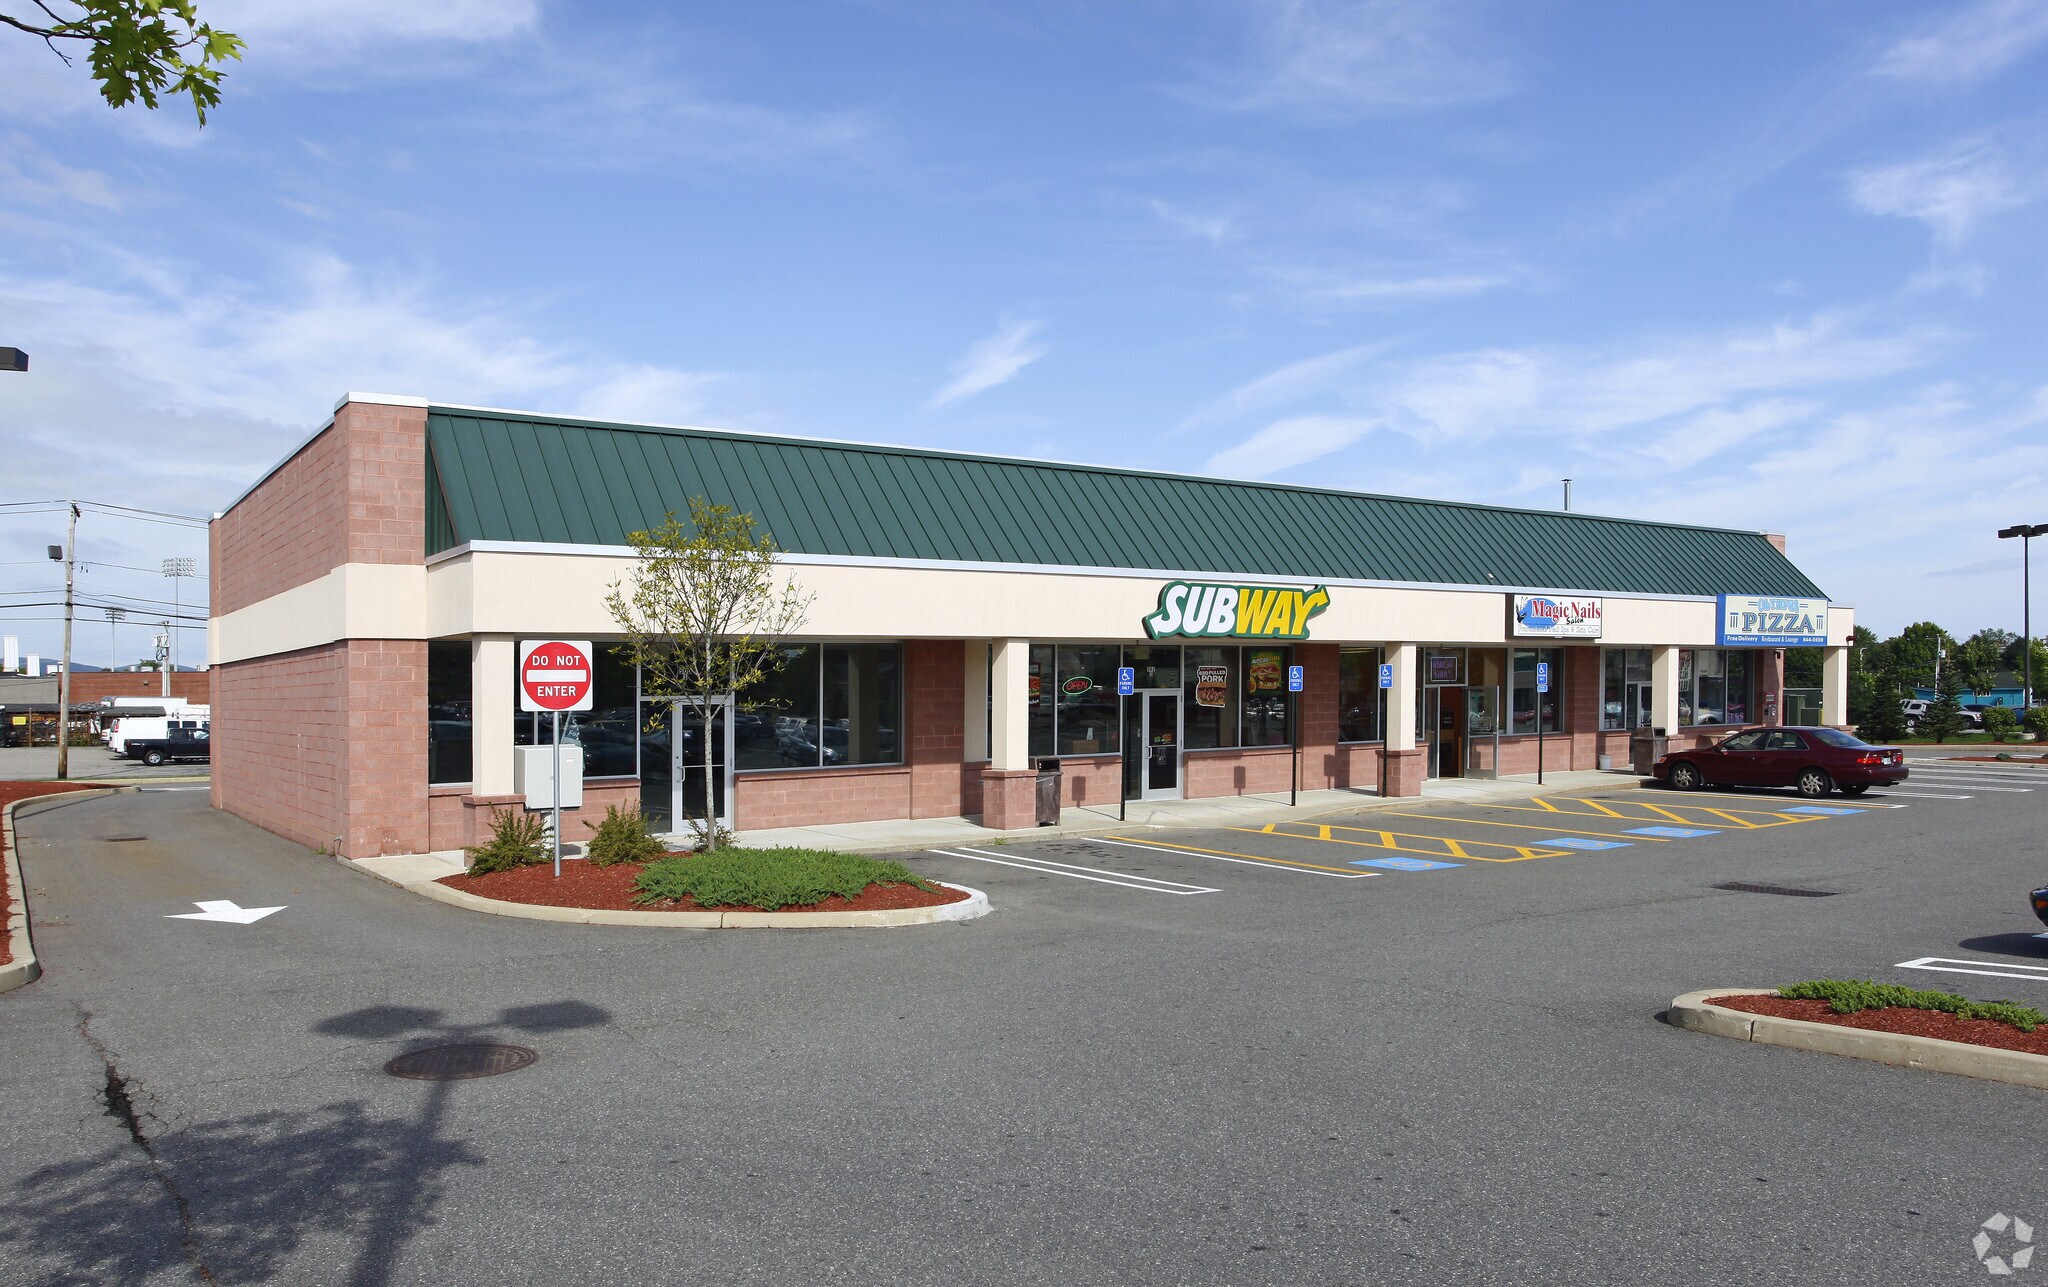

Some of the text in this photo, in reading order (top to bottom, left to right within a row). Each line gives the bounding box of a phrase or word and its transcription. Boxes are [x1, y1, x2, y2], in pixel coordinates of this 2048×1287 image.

[1150, 584, 1328, 636] SUBWAY
[1531, 600, 1601, 622] Magic Nails
[1566, 616, 1584, 625] Salon
[1742, 612, 1815, 633] PIZZA
[1561, 626, 1570, 634] Spa
[532, 655, 580, 666] DO NOT
[1201, 675, 1224, 683] PORK
[537, 685, 576, 697] ENTER
[1066, 680, 1088, 691] OPEN
